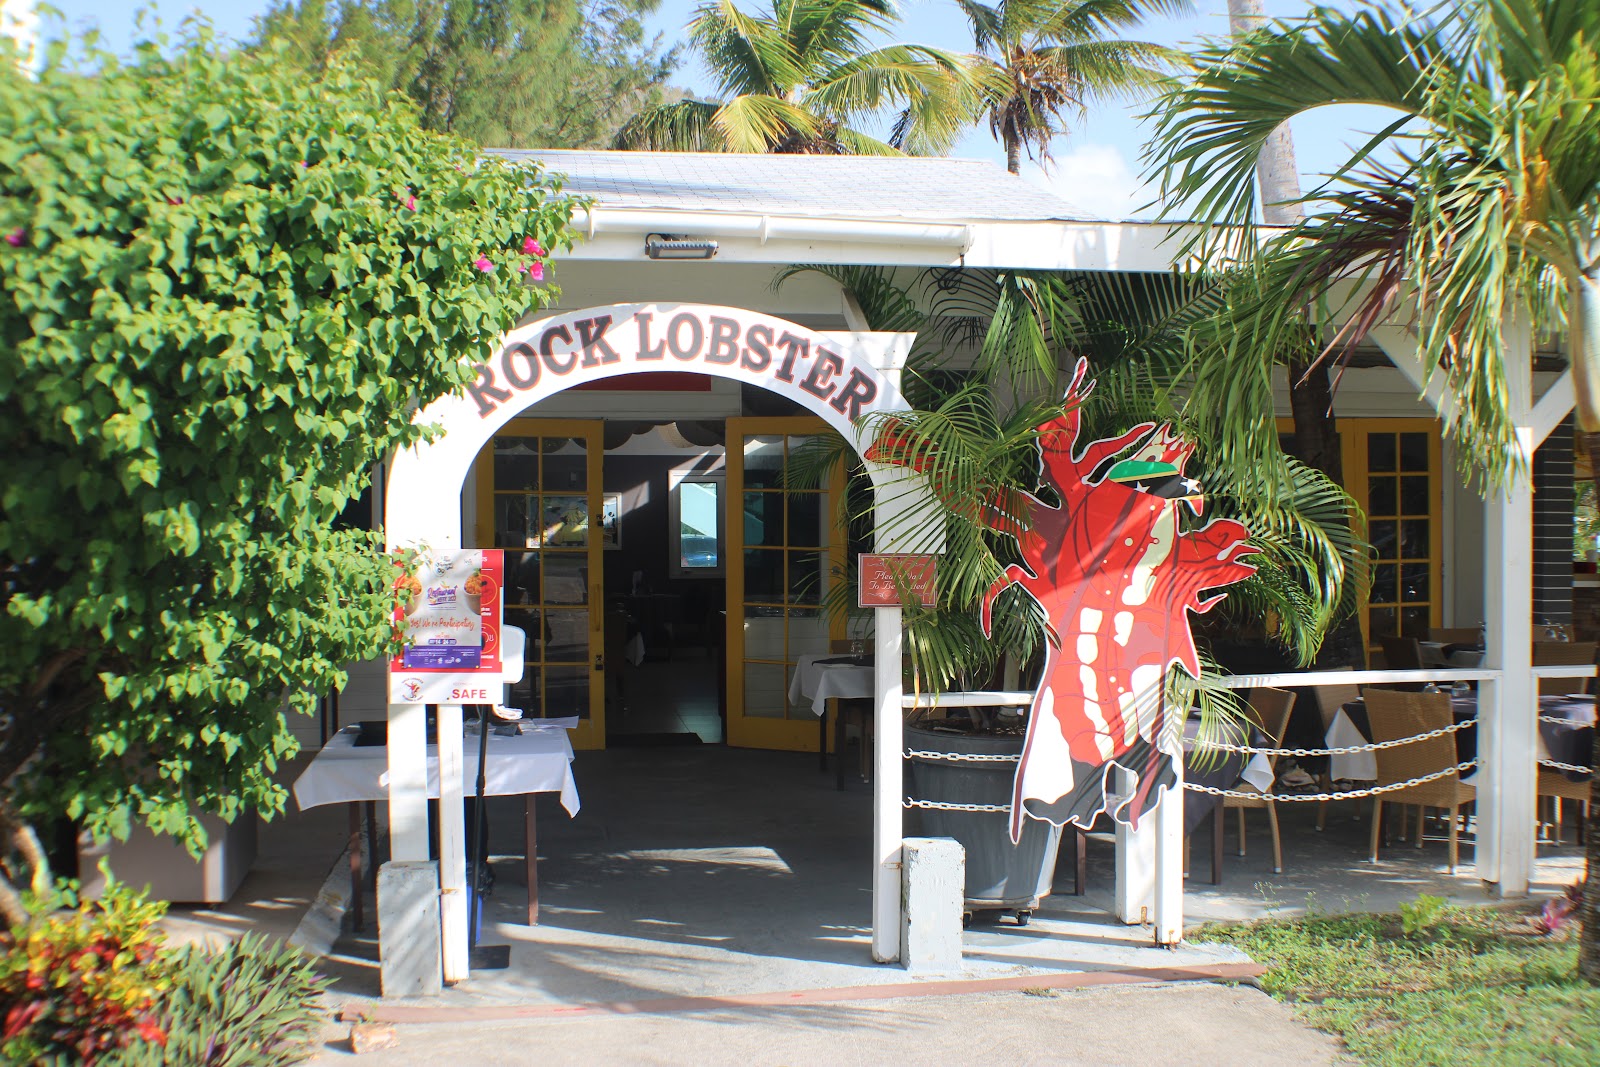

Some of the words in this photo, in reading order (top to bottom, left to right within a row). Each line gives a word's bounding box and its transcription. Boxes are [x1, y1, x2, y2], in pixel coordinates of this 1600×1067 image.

[465, 314, 620, 419] ROCK
[634, 311, 878, 424] LOBSTER
[874, 570, 902, 580] Pleae
[869, 580, 880, 590] To
[883, 580, 896, 590] Be
[900, 580, 927, 590] Sted
[452, 688, 487, 699] SAFE
